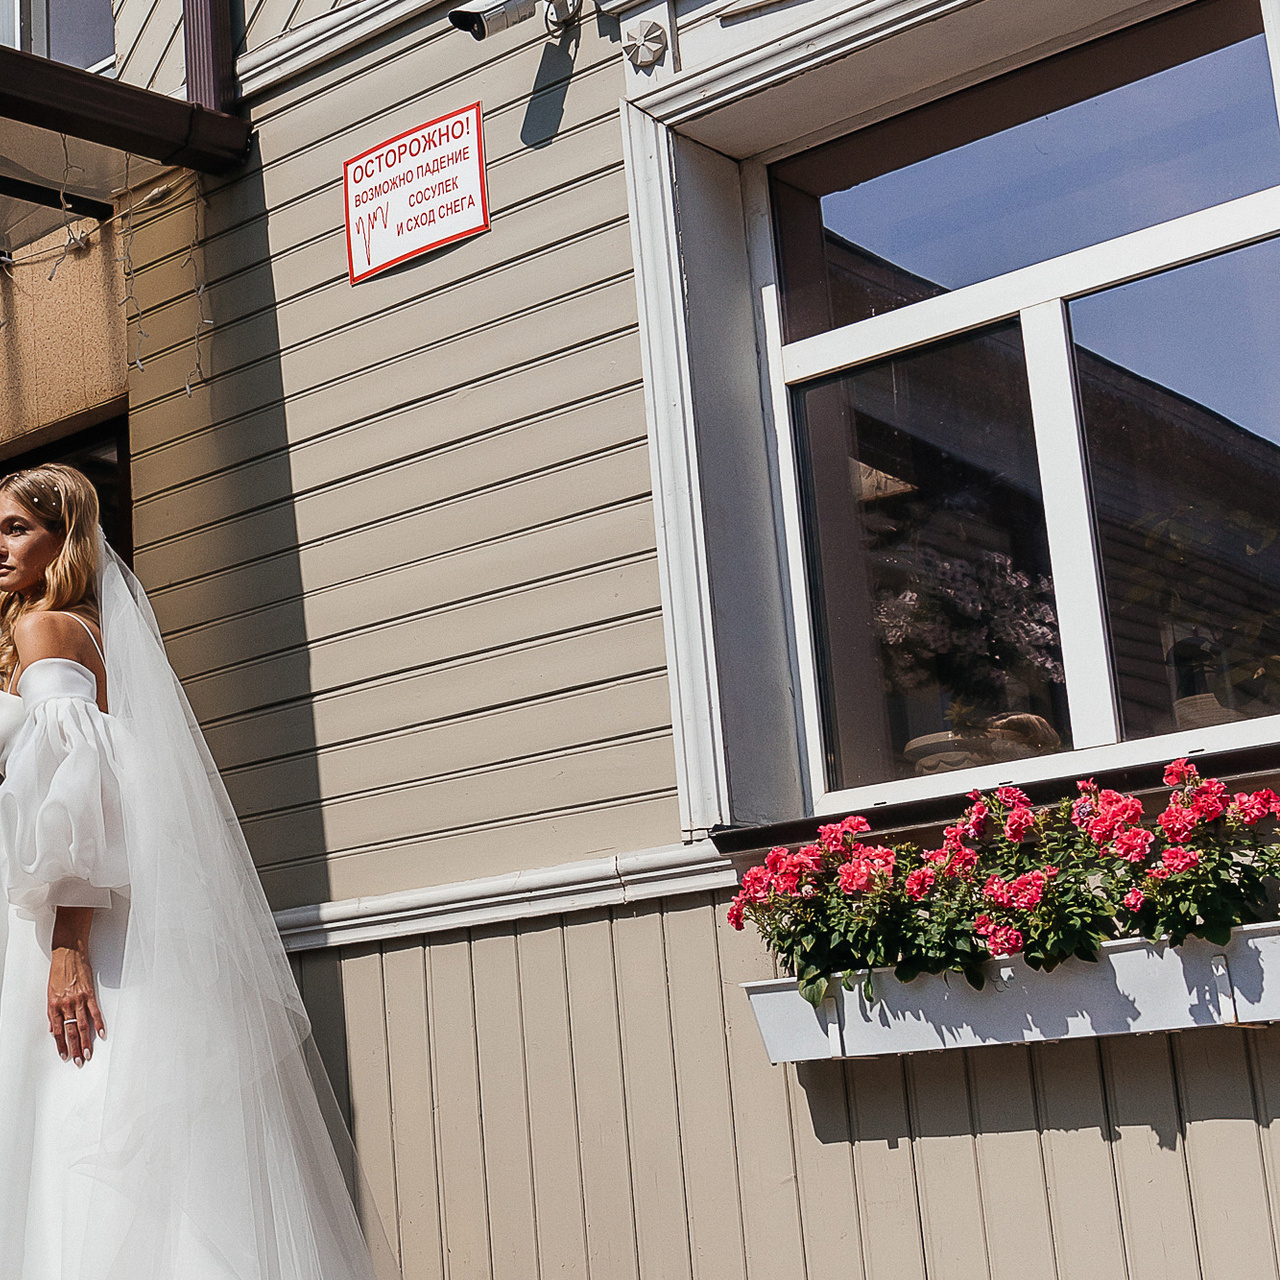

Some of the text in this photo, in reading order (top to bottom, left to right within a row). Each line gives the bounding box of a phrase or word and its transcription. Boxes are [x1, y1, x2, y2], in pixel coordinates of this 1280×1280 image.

[353, 116, 470, 184] ОСТОРОЖНО!
[355, 146, 470, 207] ВОЗМОЖНО ПАДЕНИЕ
[408, 175, 459, 207] СОСУЛЕК
[396, 194, 476, 236] И СХОД СНЕГА
